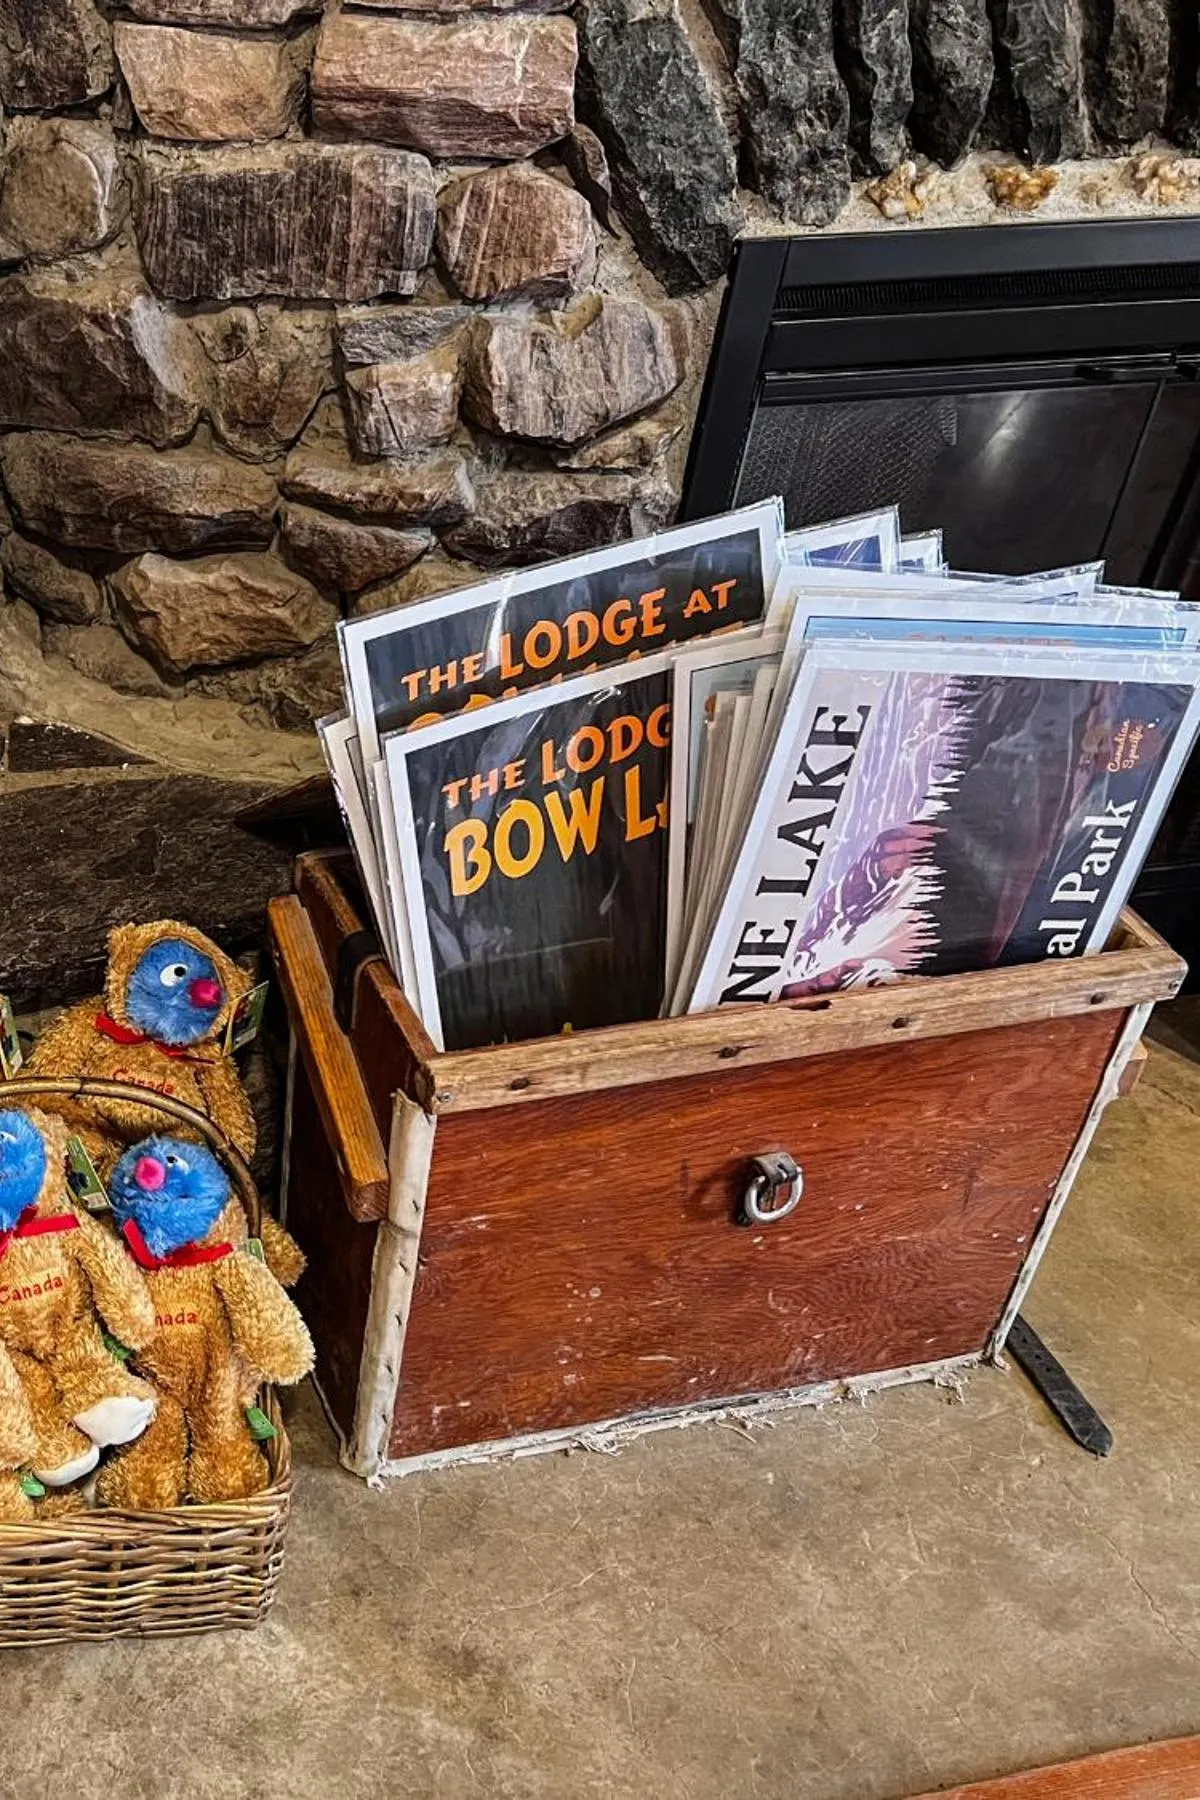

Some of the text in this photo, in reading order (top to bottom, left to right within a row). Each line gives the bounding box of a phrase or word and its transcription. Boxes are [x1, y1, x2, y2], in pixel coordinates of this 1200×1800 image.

[401, 652, 485, 702] THE
[500, 587, 667, 682] LODGE
[683, 580, 737, 619] AT
[441, 703, 670, 809] THE LODG
[1107, 719, 1131, 772] Canadian
[443, 764, 668, 897] BOW L
[718, 705, 872, 1005] NE LAKE
[1038, 799, 1138, 956] al Park
[154, 1308, 199, 1327] nada
